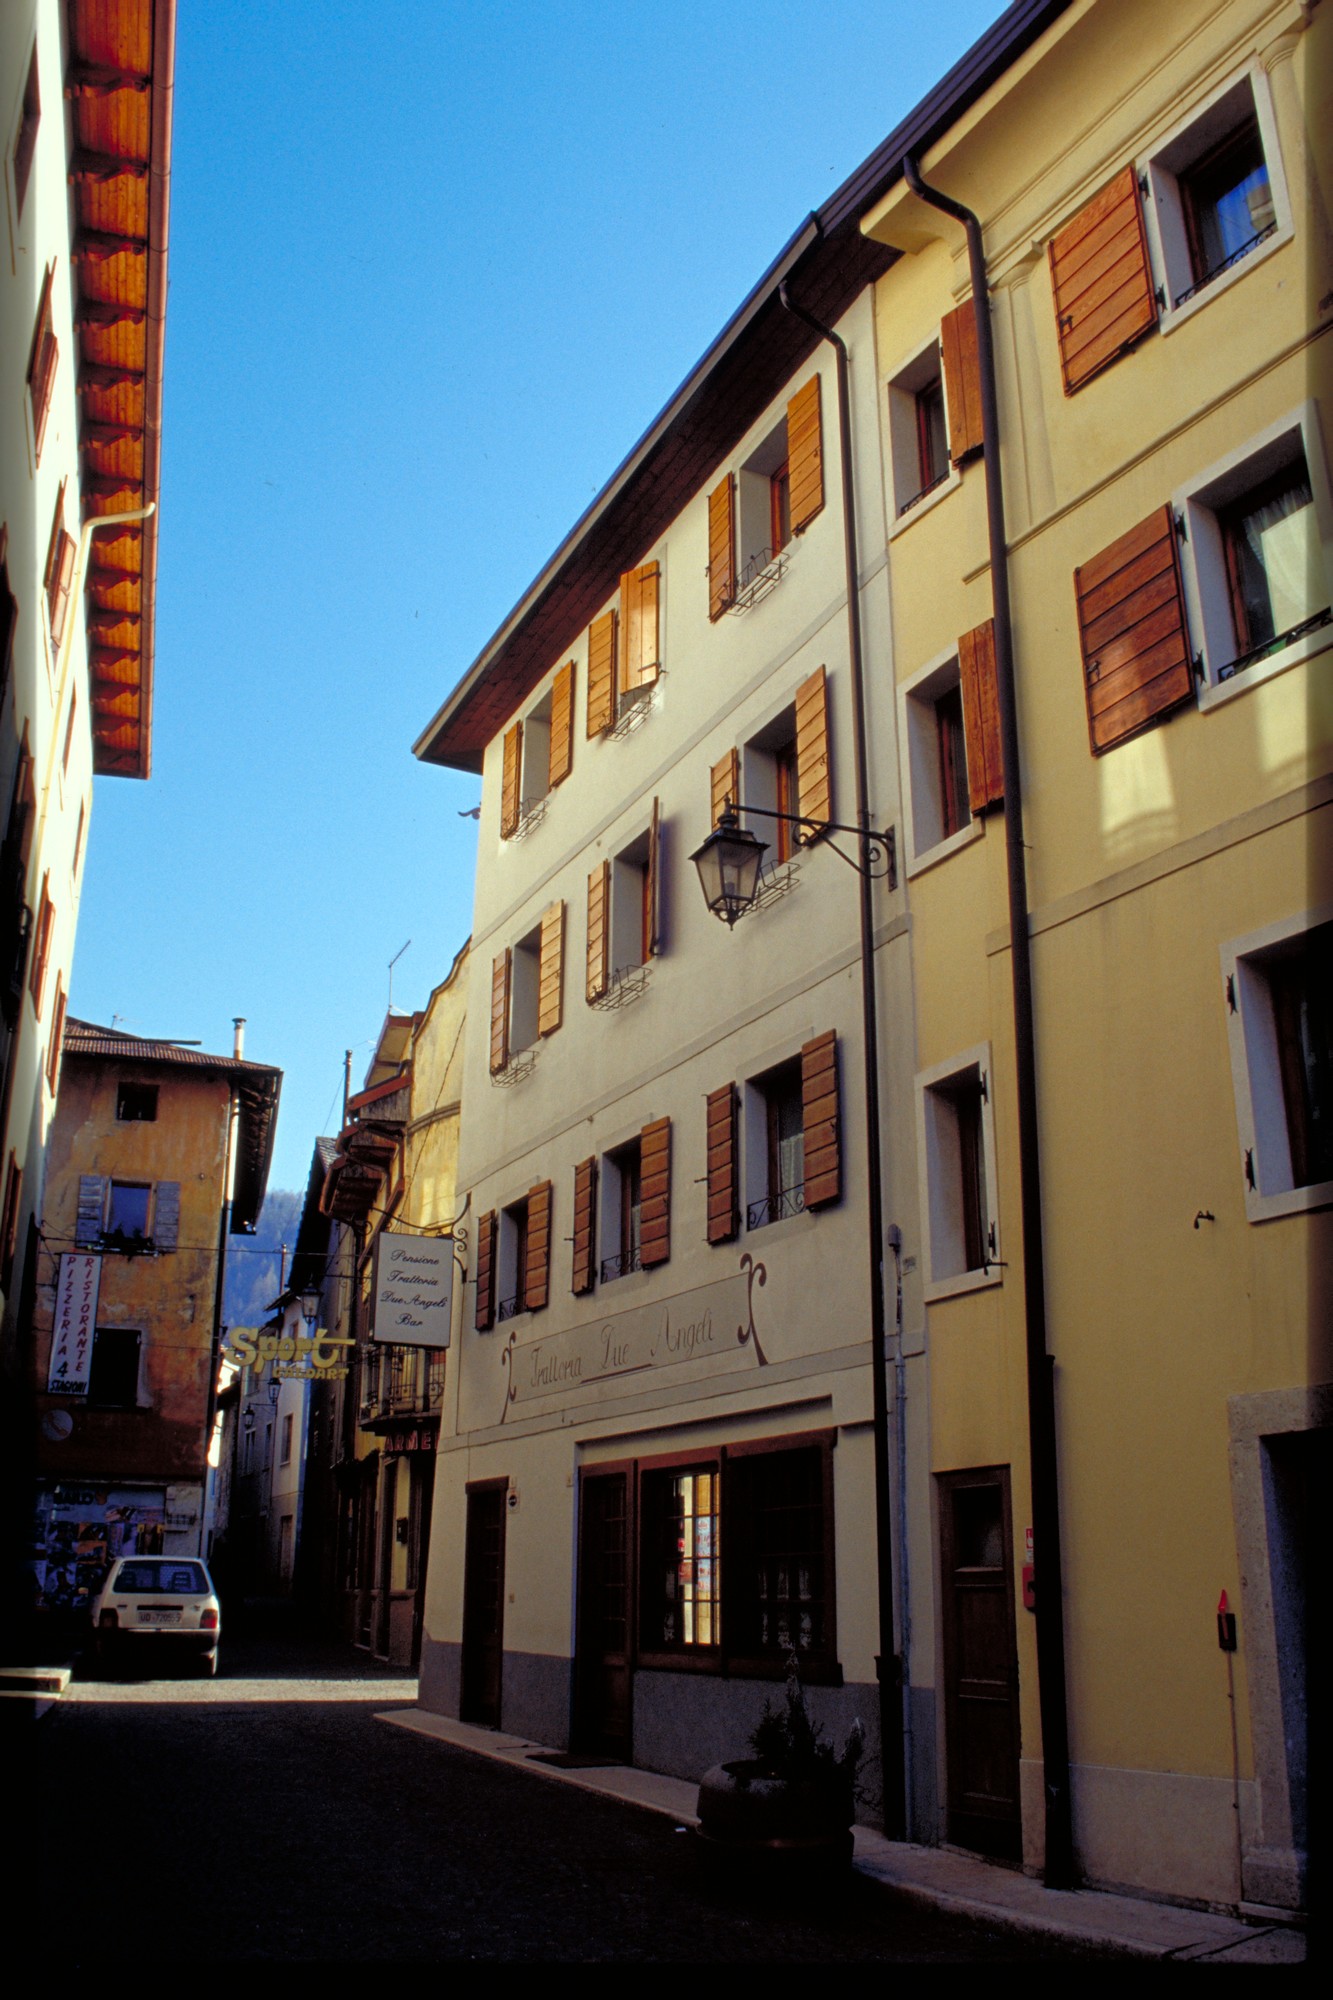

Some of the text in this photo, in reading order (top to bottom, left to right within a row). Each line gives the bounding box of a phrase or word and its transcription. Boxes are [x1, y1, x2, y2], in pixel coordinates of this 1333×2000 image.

[390, 1249, 439, 1265] Pensione
[387, 1270, 438, 1286] Trattoria
[58, 1256, 77, 1356] PIZZERIA
[380, 1290, 448, 1310] Due Angeli
[75, 1257, 95, 1372] RISTORANTE
[395, 1313, 423, 1326] Bar
[223, 1327, 356, 1373] Sport
[530, 1306, 714, 1388] Trattoria Due Angeli
[57, 1361, 69, 1377] 4
[49, 1380, 88, 1393] STAGIONI
